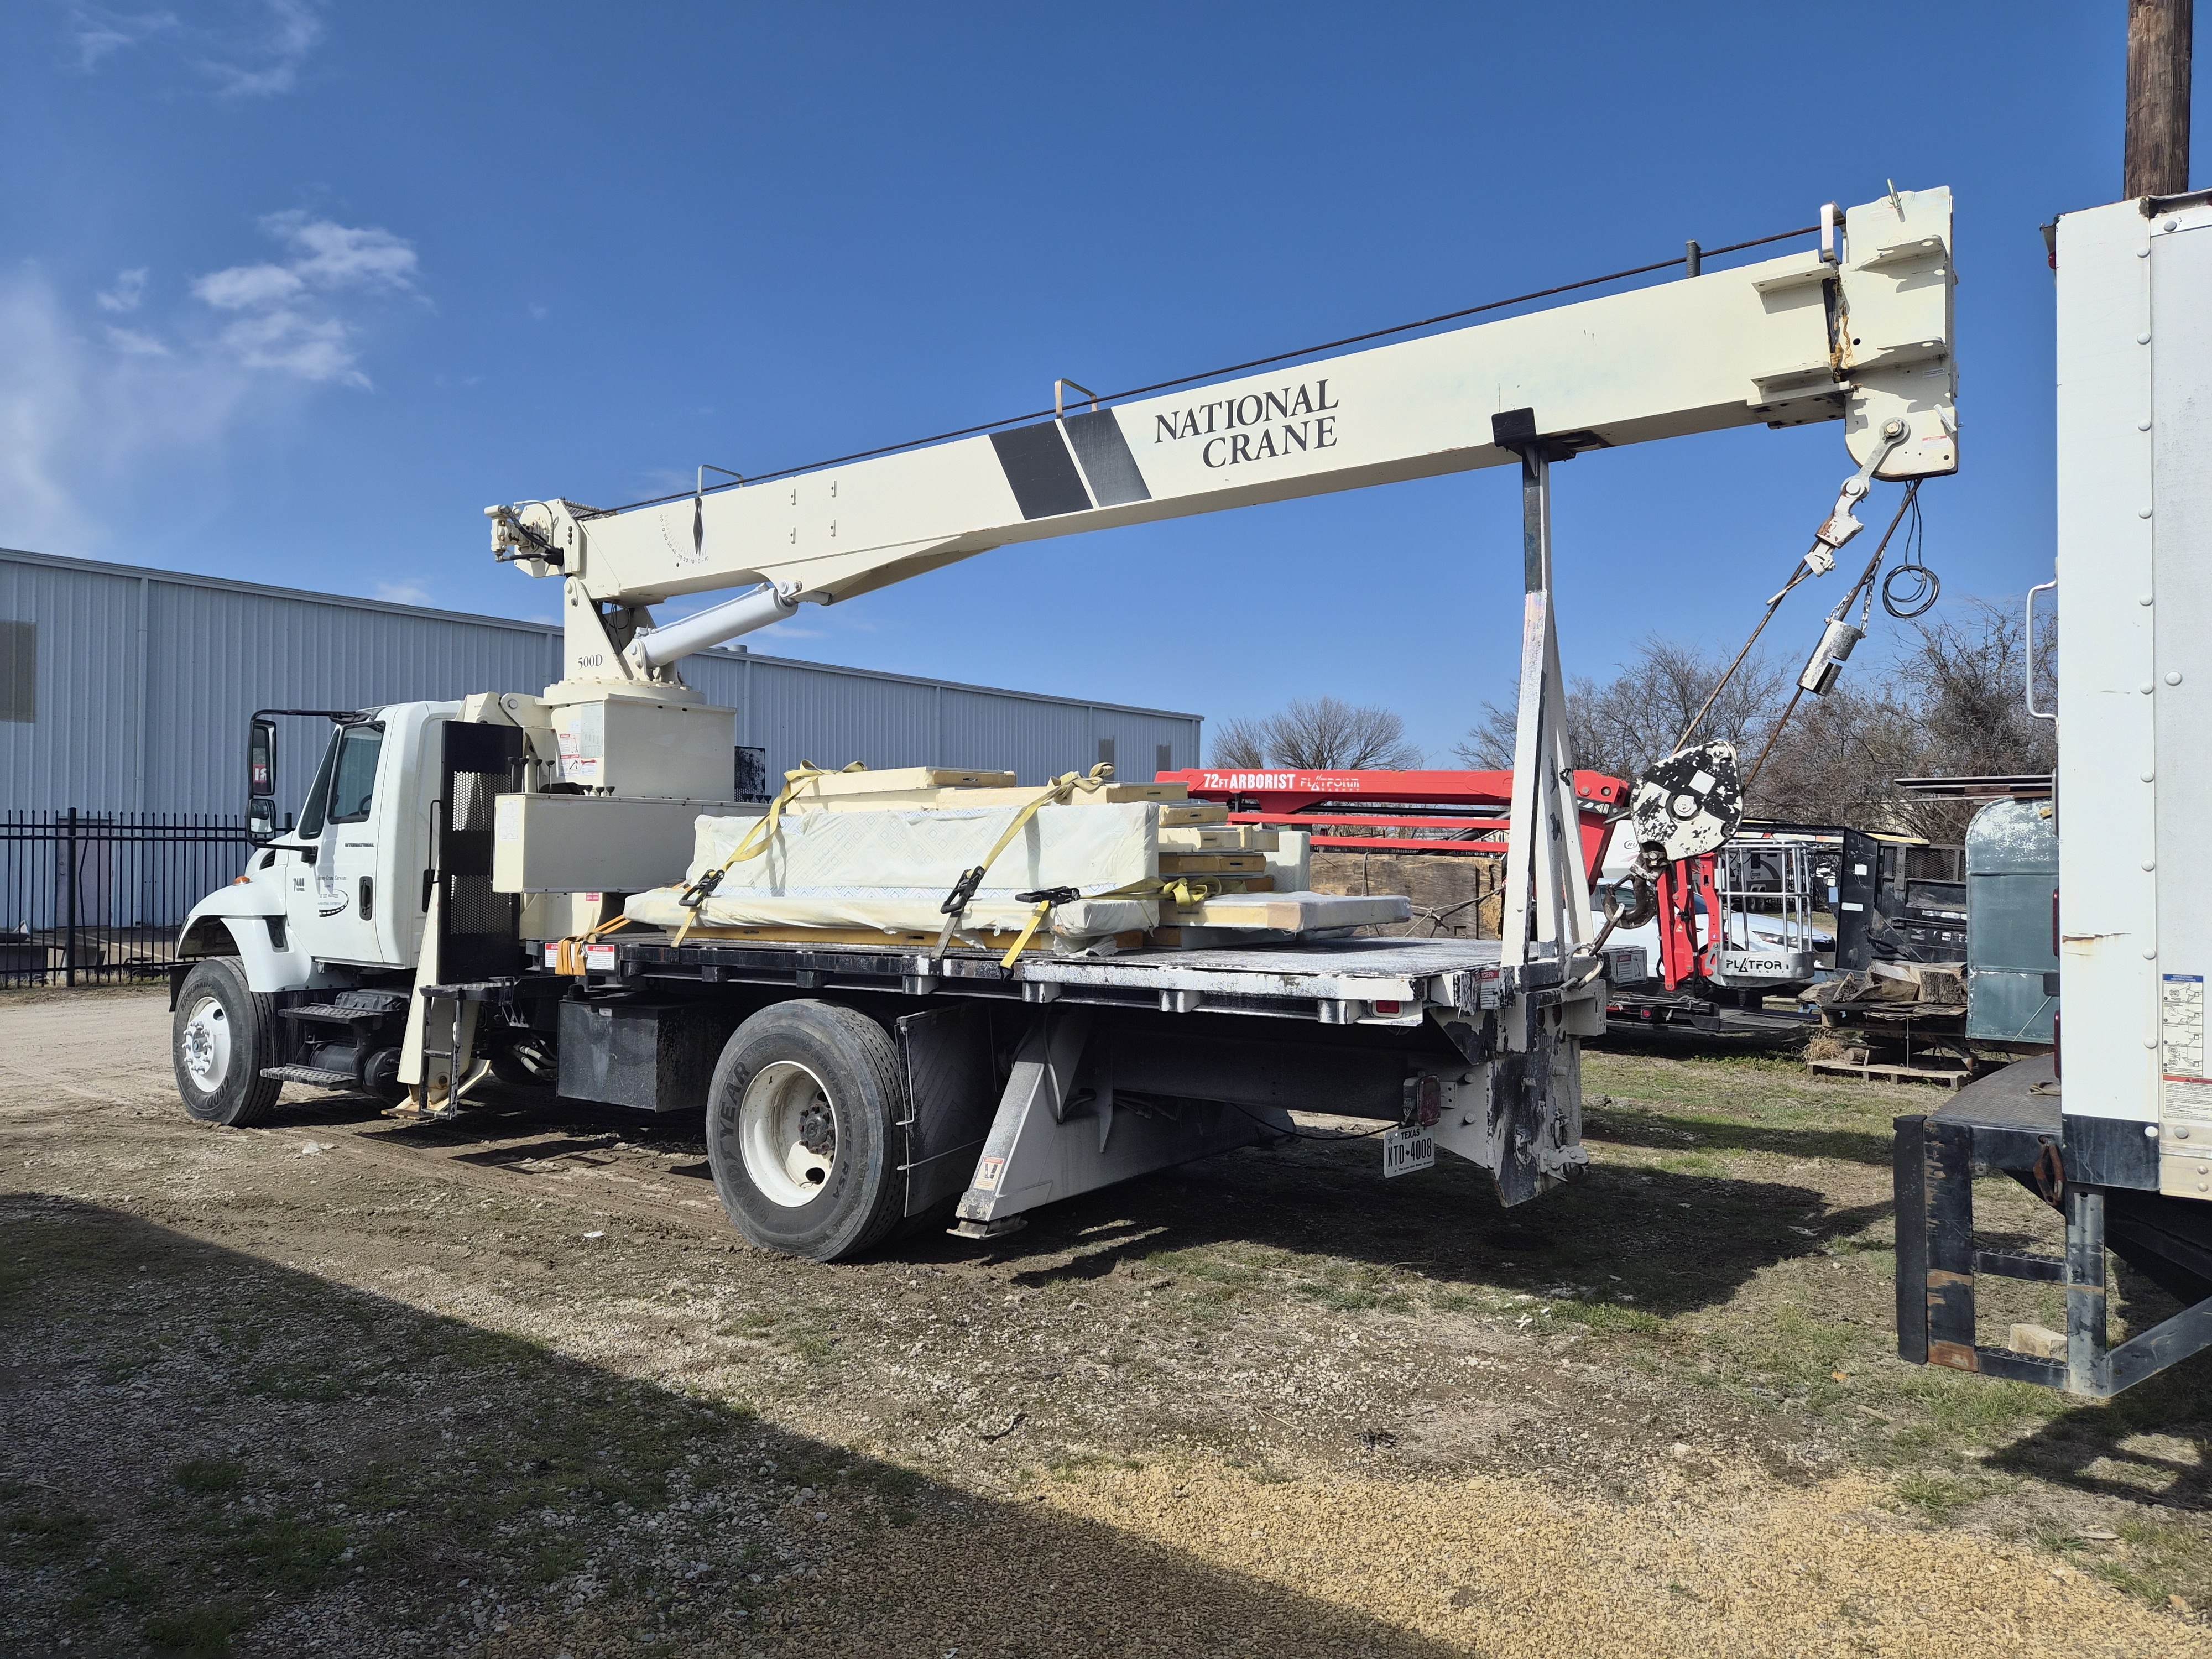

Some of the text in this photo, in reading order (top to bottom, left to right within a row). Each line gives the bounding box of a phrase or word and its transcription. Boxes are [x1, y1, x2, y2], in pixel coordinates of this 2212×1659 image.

[1154, 379, 1339, 444] NATIONAL
[1203, 415, 1337, 468] CRANE
[578, 654, 603, 670] 500D
[1229, 774, 1296, 789] ARBORIST
[1726, 956, 1789, 972] PLATFOR
[1401, 1128, 1420, 1140] TEXAS
[832, 1161, 849, 1200] RSA
